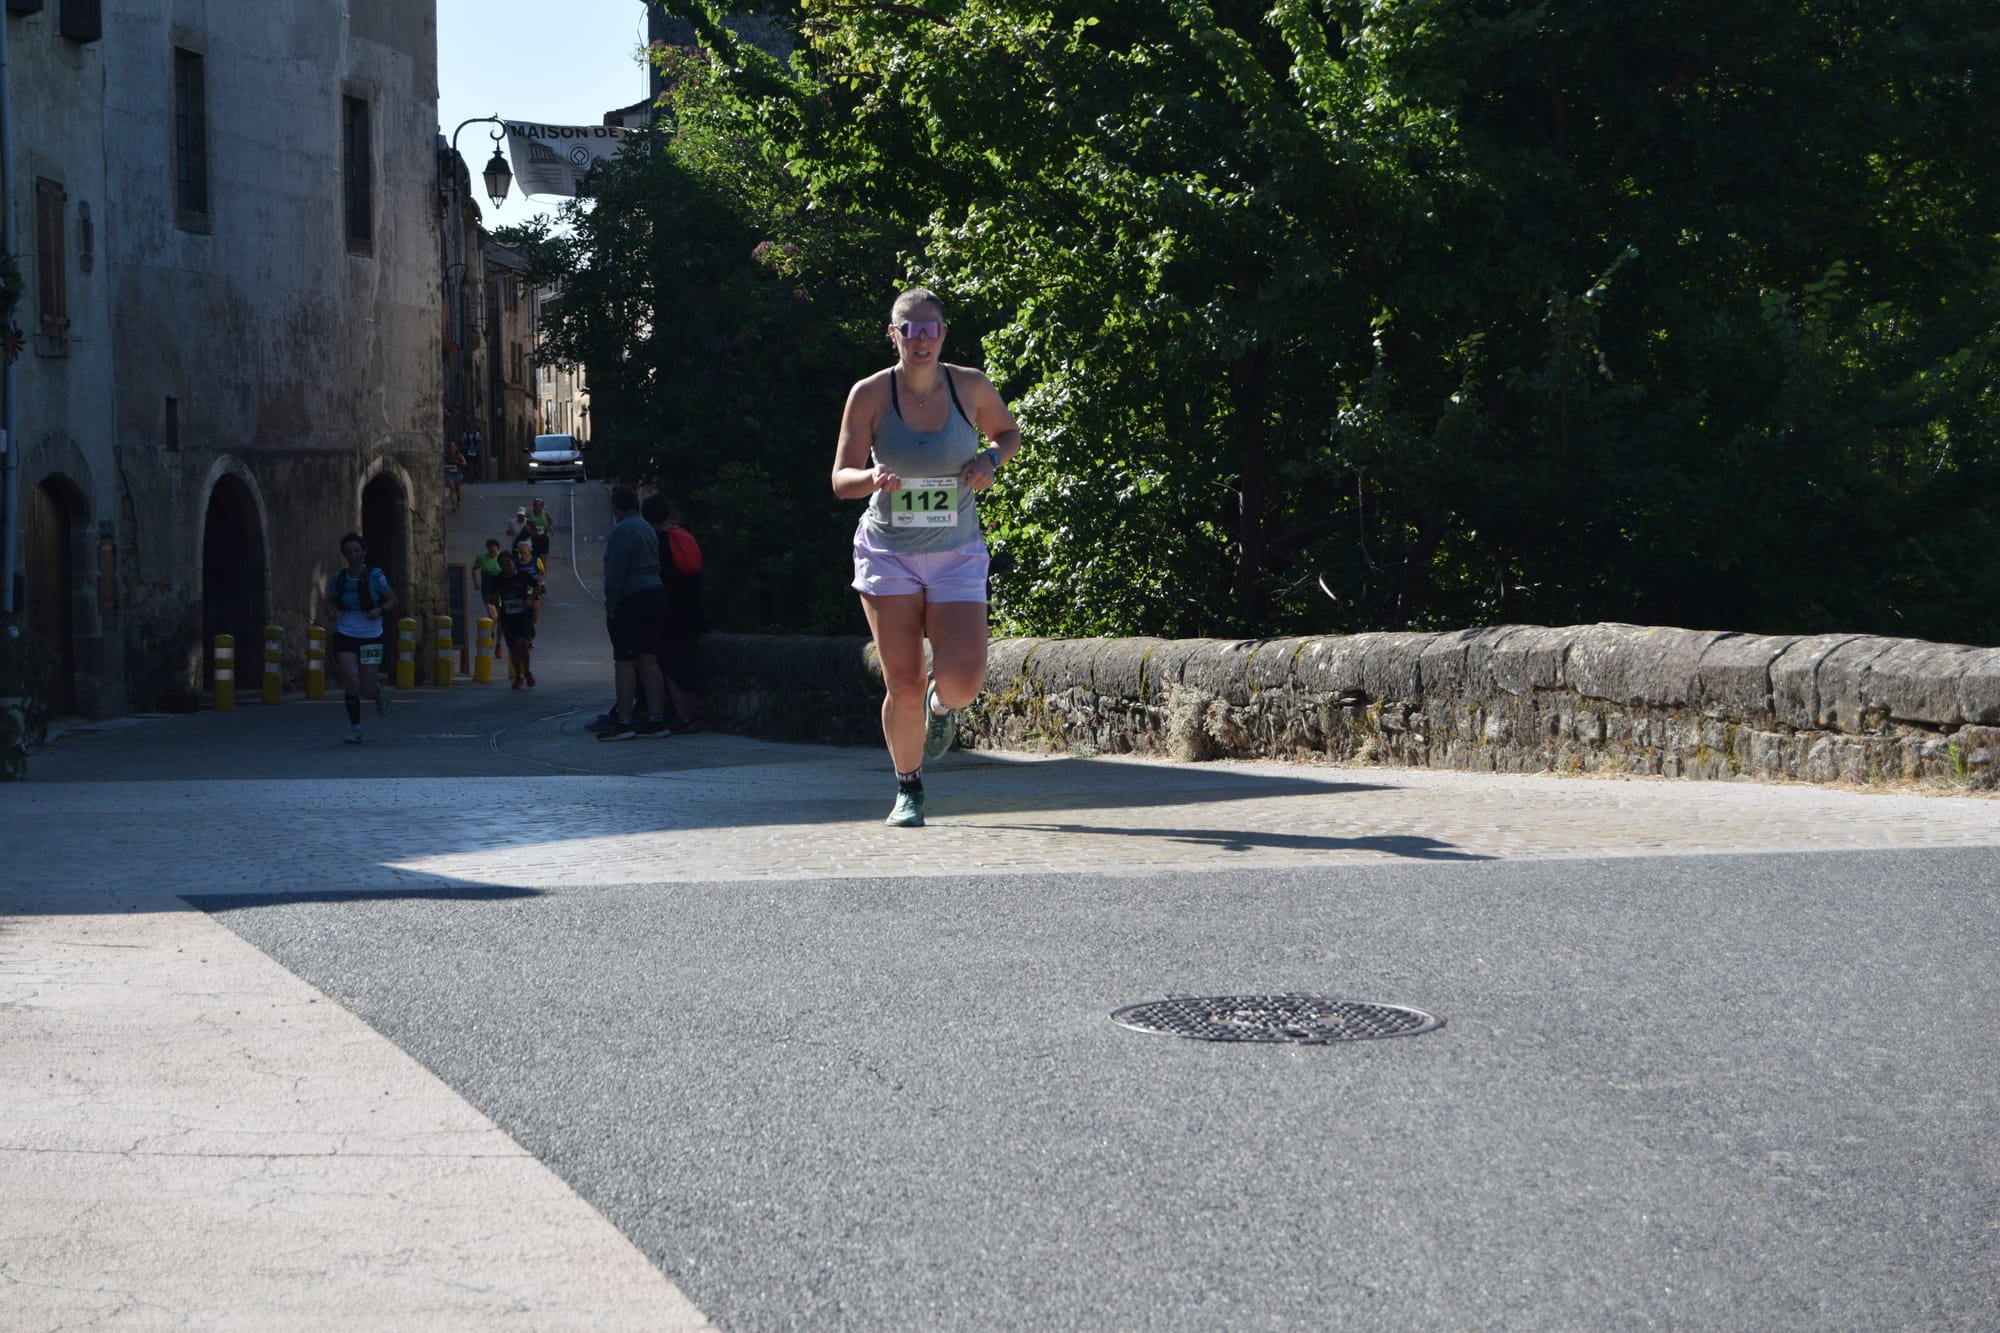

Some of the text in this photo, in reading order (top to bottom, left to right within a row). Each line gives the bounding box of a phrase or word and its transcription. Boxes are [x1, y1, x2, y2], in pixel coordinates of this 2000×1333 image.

[511, 125, 619, 139] MAISON DE
[901, 491, 949, 511] 112
